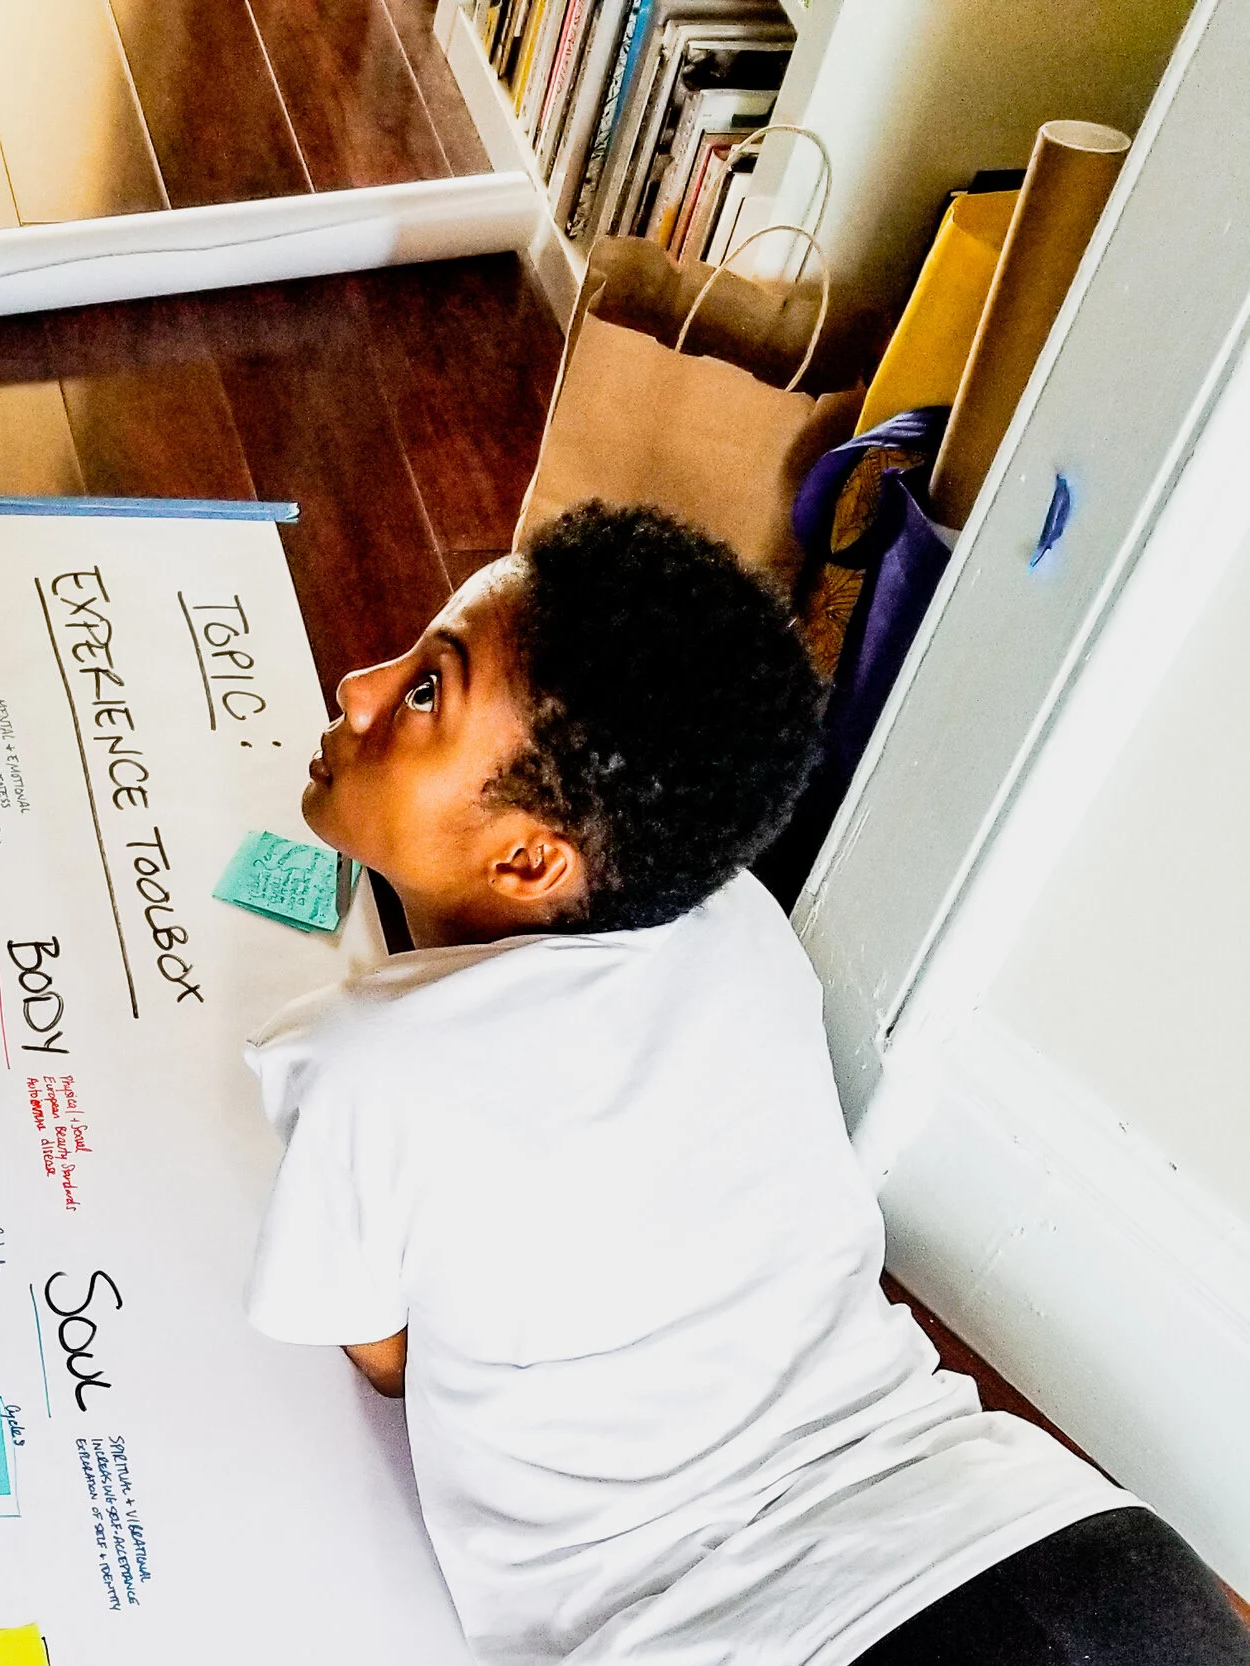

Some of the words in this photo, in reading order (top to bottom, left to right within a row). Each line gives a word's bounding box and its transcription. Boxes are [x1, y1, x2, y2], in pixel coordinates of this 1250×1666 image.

[5, 755, 29, 814] EMOTIONAL
[51, 565, 149, 810] EXPERIENCE
[126, 826, 203, 1003] TOOLBOX
[6, 936, 69, 1054] BODY
[42, 1076, 59, 1119] European
[55, 1075, 84, 1114] Physical
[54, 1126, 71, 1160] Beauty
[60, 1163, 80, 1212] Standards
[0, 1405, 25, 1447] Cycles
[90, 1438, 114, 1504] INCREASING
[90, 1507, 100, 1520] OF
[107, 1435, 133, 1495] SPIRITUAL
[125, 1510, 150, 1583] VIBRATIONAL
[93, 1524, 106, 1549] SELF
[98, 1563, 120, 1611] IDENTITY
